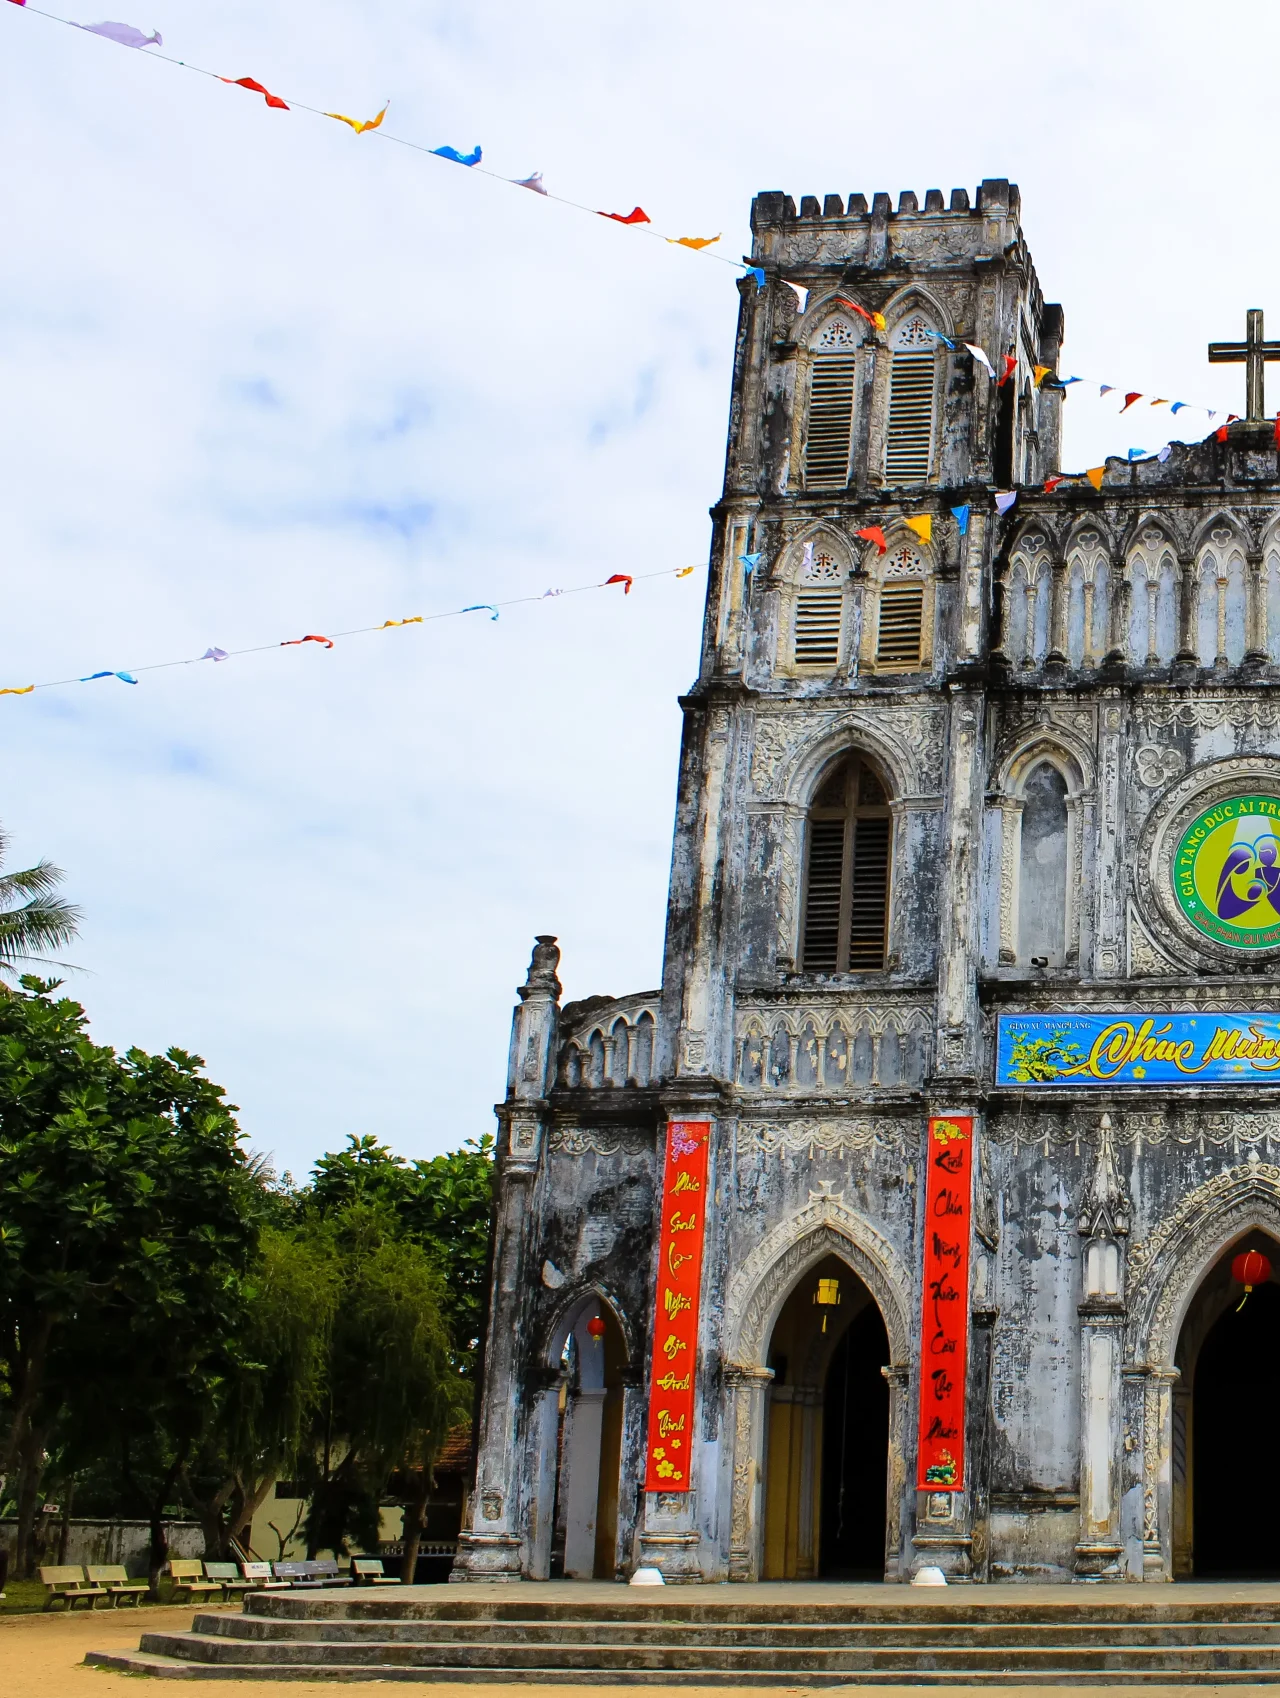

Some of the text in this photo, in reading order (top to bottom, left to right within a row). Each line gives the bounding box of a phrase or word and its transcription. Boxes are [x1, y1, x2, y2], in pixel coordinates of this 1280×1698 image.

[1180, 871, 1195, 896] GIA
[1243, 933, 1260, 945] QUI
[1058, 1018, 1208, 1079] Chúc
[669, 1171, 700, 1195] Phúc
[933, 1188, 963, 1217] Chúa
[670, 1211, 696, 1233] Sinh
[664, 1287, 692, 1321] Nghĩa
[929, 1272, 960, 1329] Xuân
[663, 1334, 687, 1360] Gia
[656, 1371, 690, 1391] Đình
[657, 1409, 685, 1438] Thịnh
